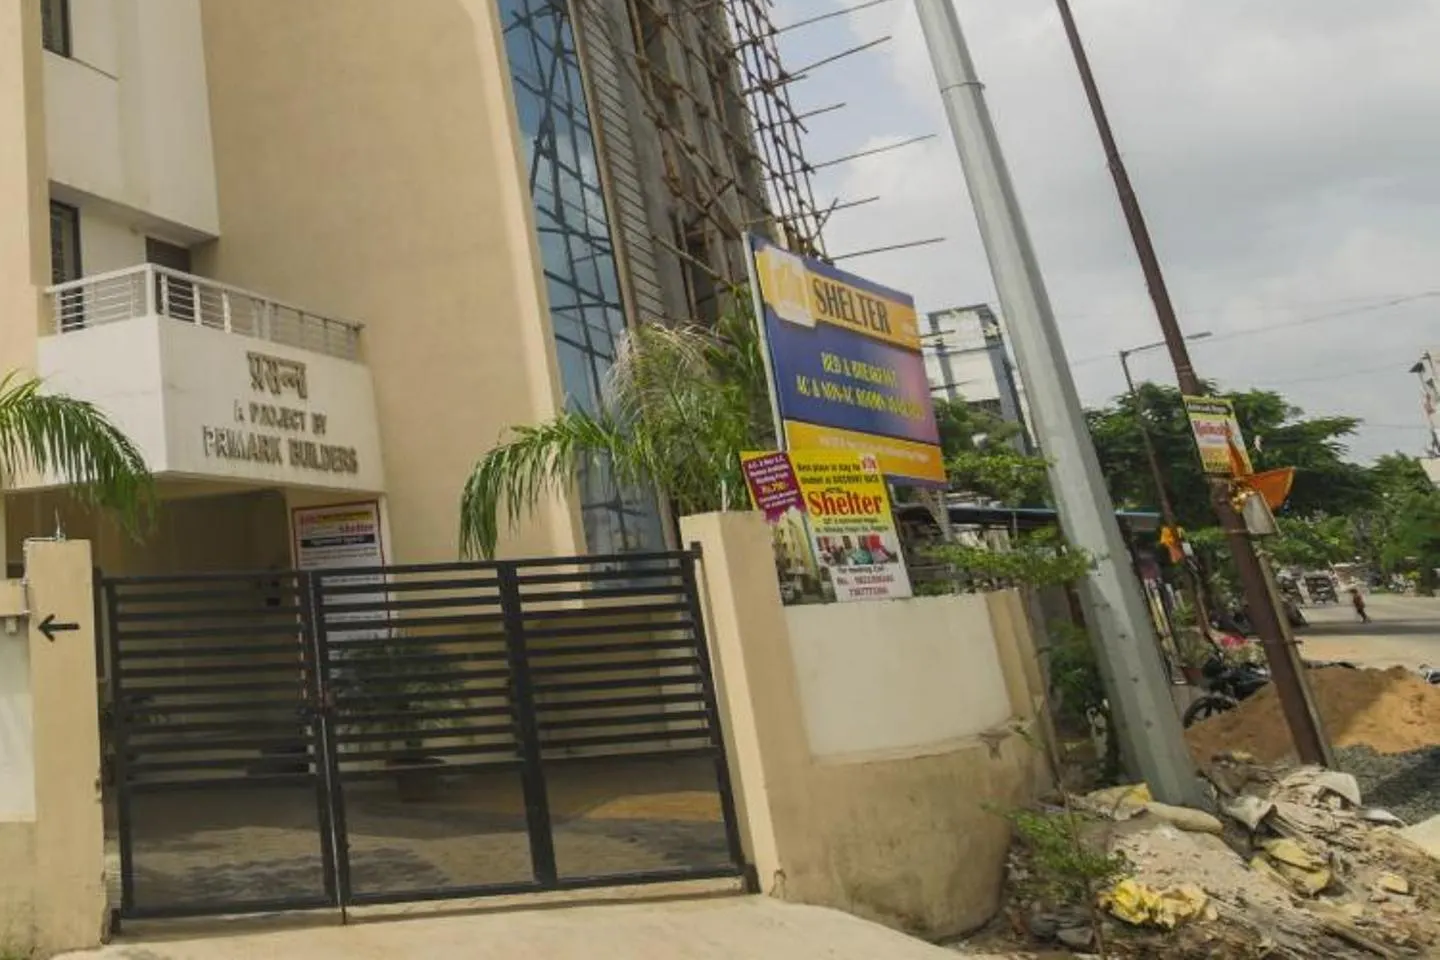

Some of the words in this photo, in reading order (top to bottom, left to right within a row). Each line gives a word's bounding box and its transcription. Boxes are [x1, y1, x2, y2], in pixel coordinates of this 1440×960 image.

[812, 278, 891, 334] SHELTER
[248, 401, 306, 432] PROJECT
[287, 437, 358, 475] BUILDERS
[808, 490, 882, 516] Shelter
